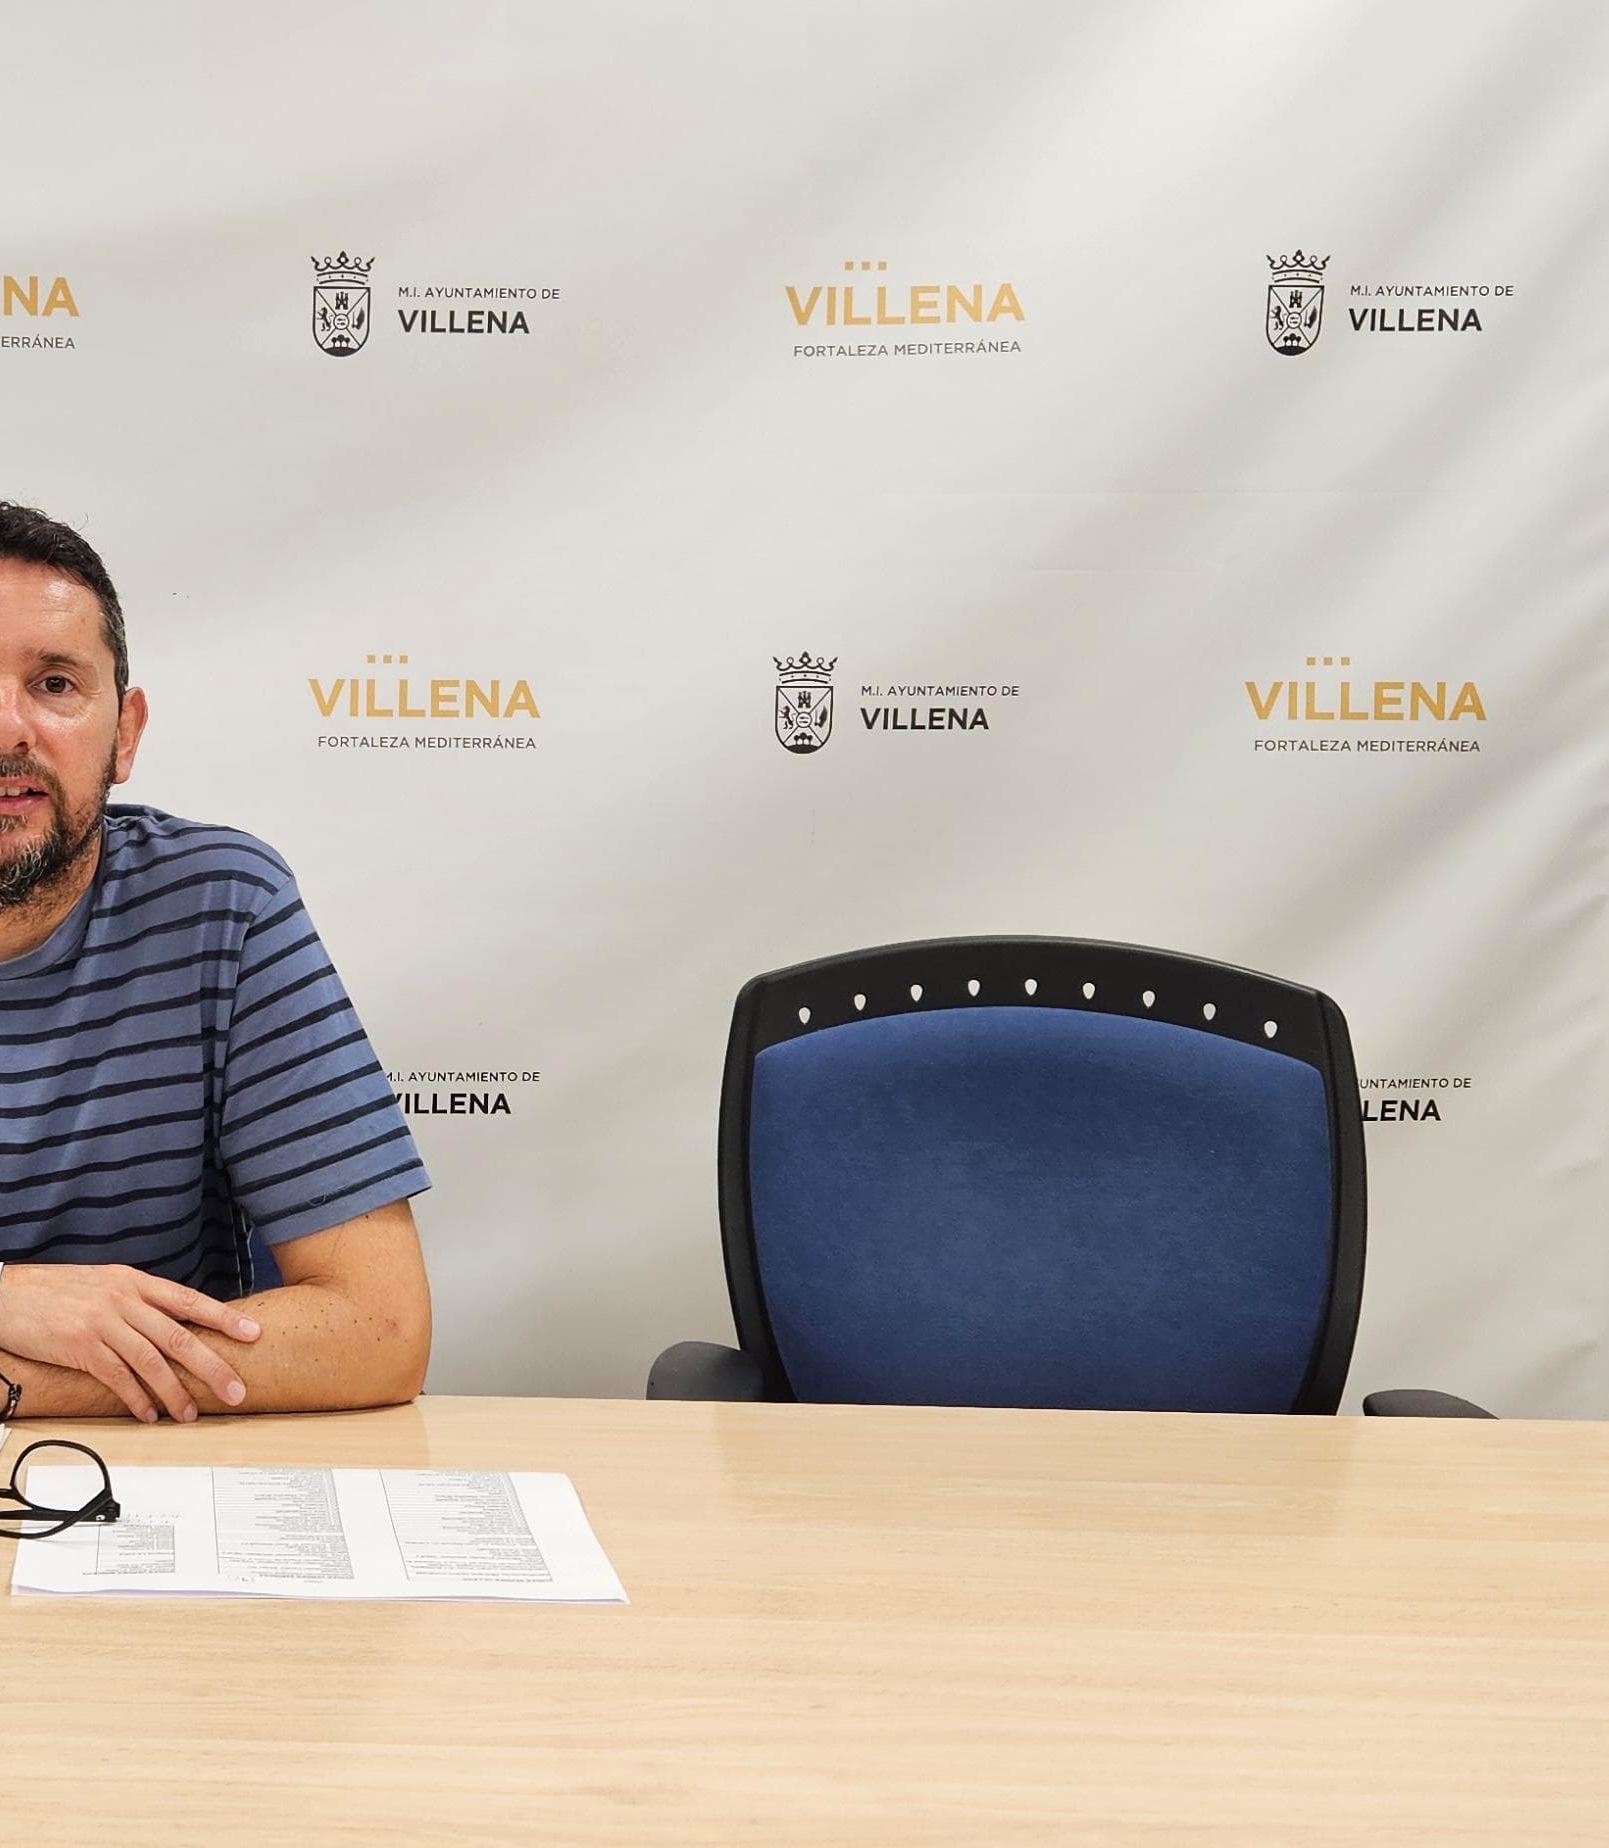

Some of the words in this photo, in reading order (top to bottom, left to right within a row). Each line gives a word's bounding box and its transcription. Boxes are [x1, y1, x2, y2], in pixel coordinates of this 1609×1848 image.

[397, 286, 421, 298] M.I.
[424, 286, 537, 300] AYUNTAMIENTO
[541, 288, 561, 300] DE
[1350, 284, 1372, 298] M.I.
[1374, 284, 1490, 298] AYUNTAMIENTO
[1494, 284, 1515, 297] DE
[784, 282, 1025, 326] VILLENA
[397, 308, 531, 335] VILLENA
[1347, 307, 1483, 332] VILLENA
[793, 344, 889, 358] FORTALEZA
[894, 338, 1022, 355] MEDITERRÁNEA
[307, 678, 541, 719] VILLENA
[861, 685, 883, 698] M.I.
[886, 684, 999, 698] AYUNTAMIENTO
[1000, 684, 1020, 697] DE
[1244, 681, 1488, 722] VILLENA
[859, 707, 990, 731] VILLENA
[317, 735, 410, 749] FORTALEZA
[414, 734, 537, 750] MEDITERRÁNEA
[1254, 739, 1352, 753] FORTALEZA
[1356, 737, 1481, 753] MEDITERRÁNEA
[407, 1071, 519, 1083] AYUNTAMIENTO
[521, 1070, 541, 1082] DE
[1360, 1078, 1450, 1089] UNTAMIENTO
[1453, 1077, 1472, 1089] DE
[1362, 1099, 1442, 1123] LENA
